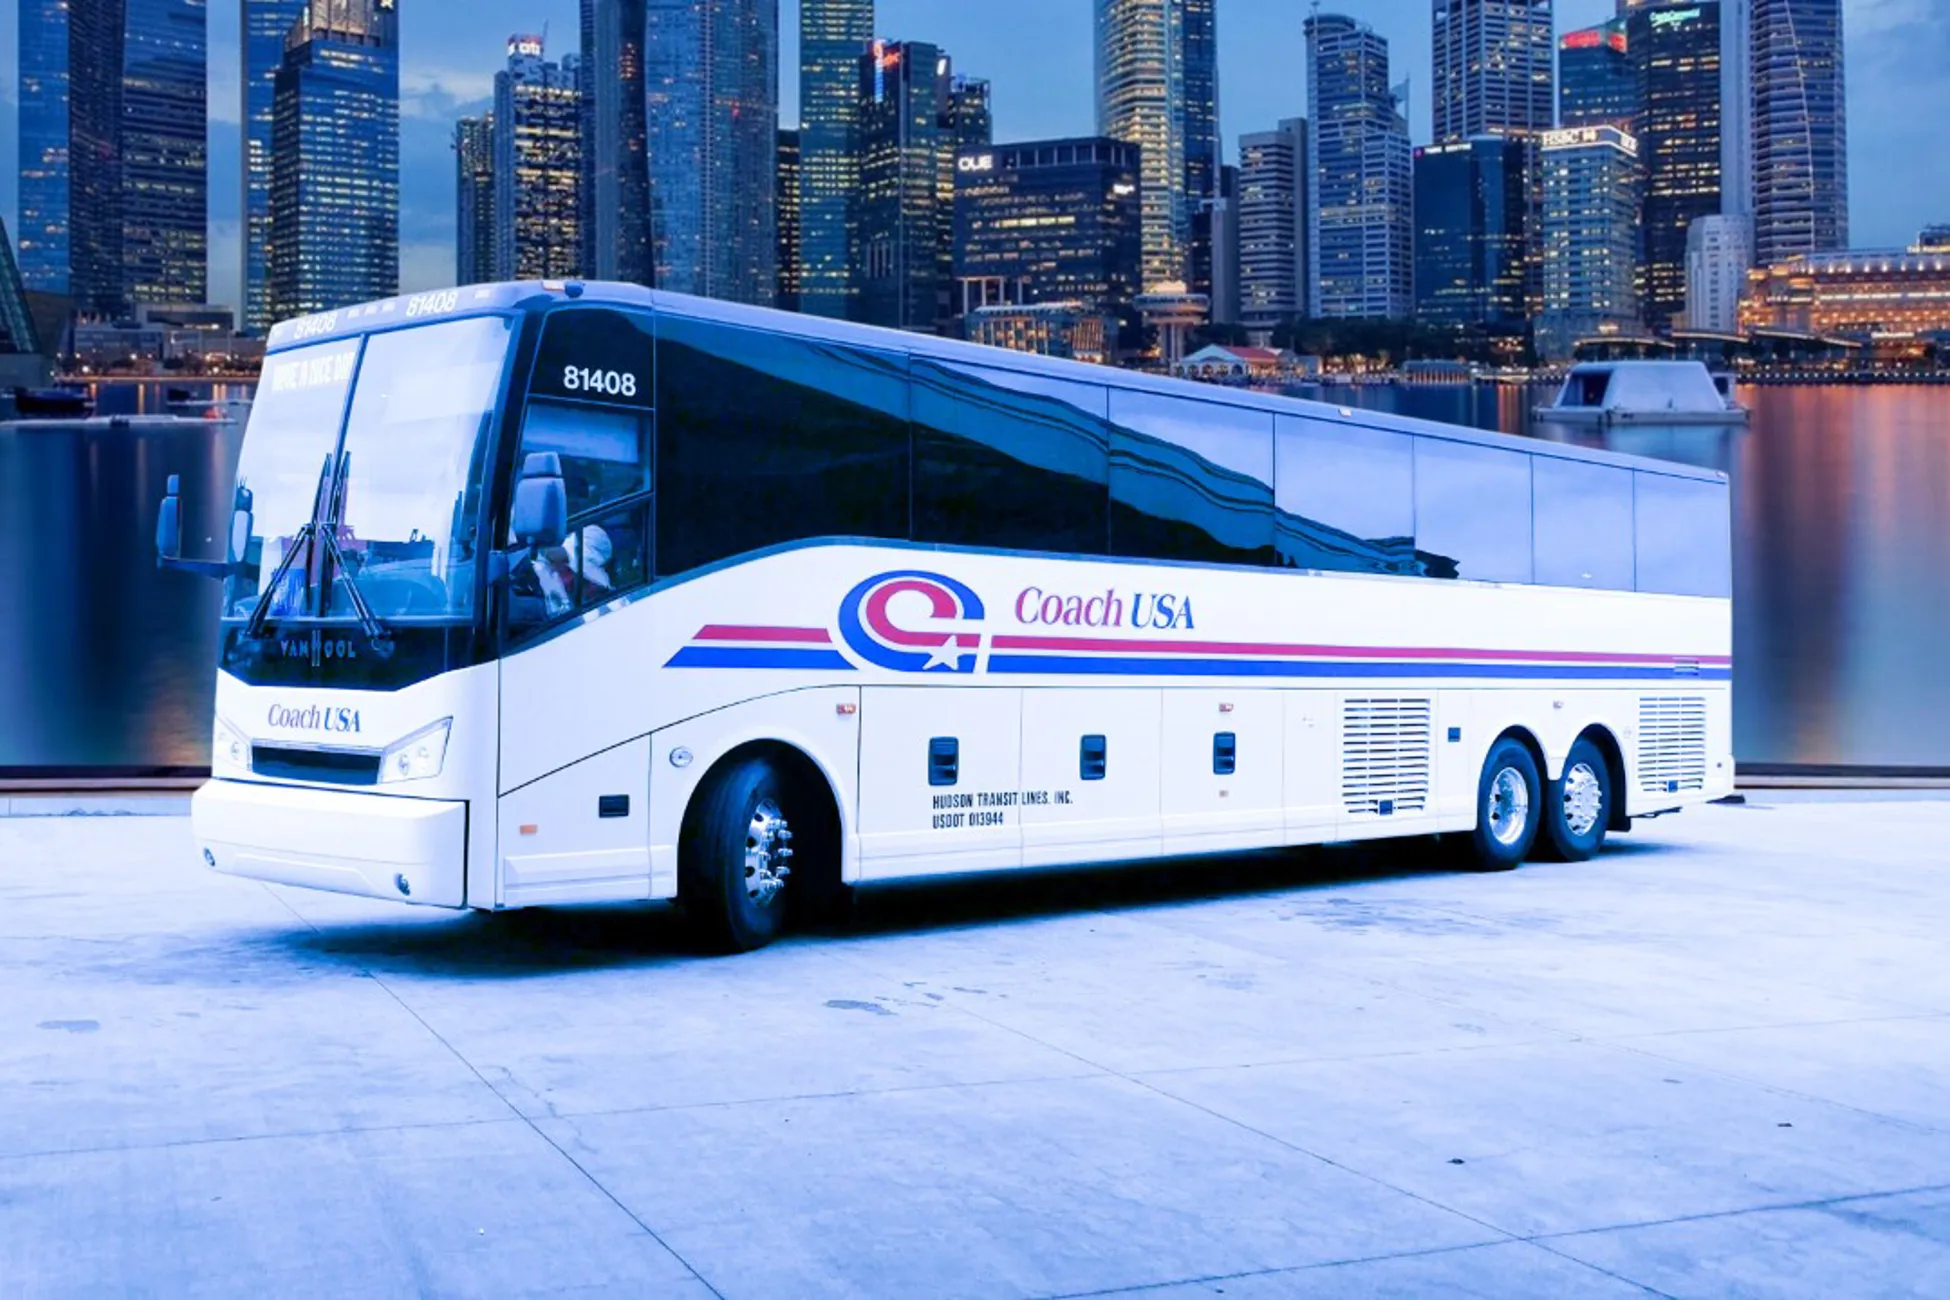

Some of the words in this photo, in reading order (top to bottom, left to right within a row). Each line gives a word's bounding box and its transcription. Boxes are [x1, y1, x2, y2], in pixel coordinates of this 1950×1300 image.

[958, 154, 993, 171] OUE
[407, 290, 459, 317] 81408
[563, 365, 636, 397] 81408
[1015, 586, 1123, 628] Coach
[1131, 591, 1195, 630] USA
[281, 639, 309, 658] VAN
[268, 703, 320, 729] Coach
[324, 706, 361, 732] USA
[933, 793, 973, 809] HUDSON
[977, 791, 1018, 807] TRANSIT
[933, 813, 965, 829] USDOT
[969, 811, 1004, 826] 013944
